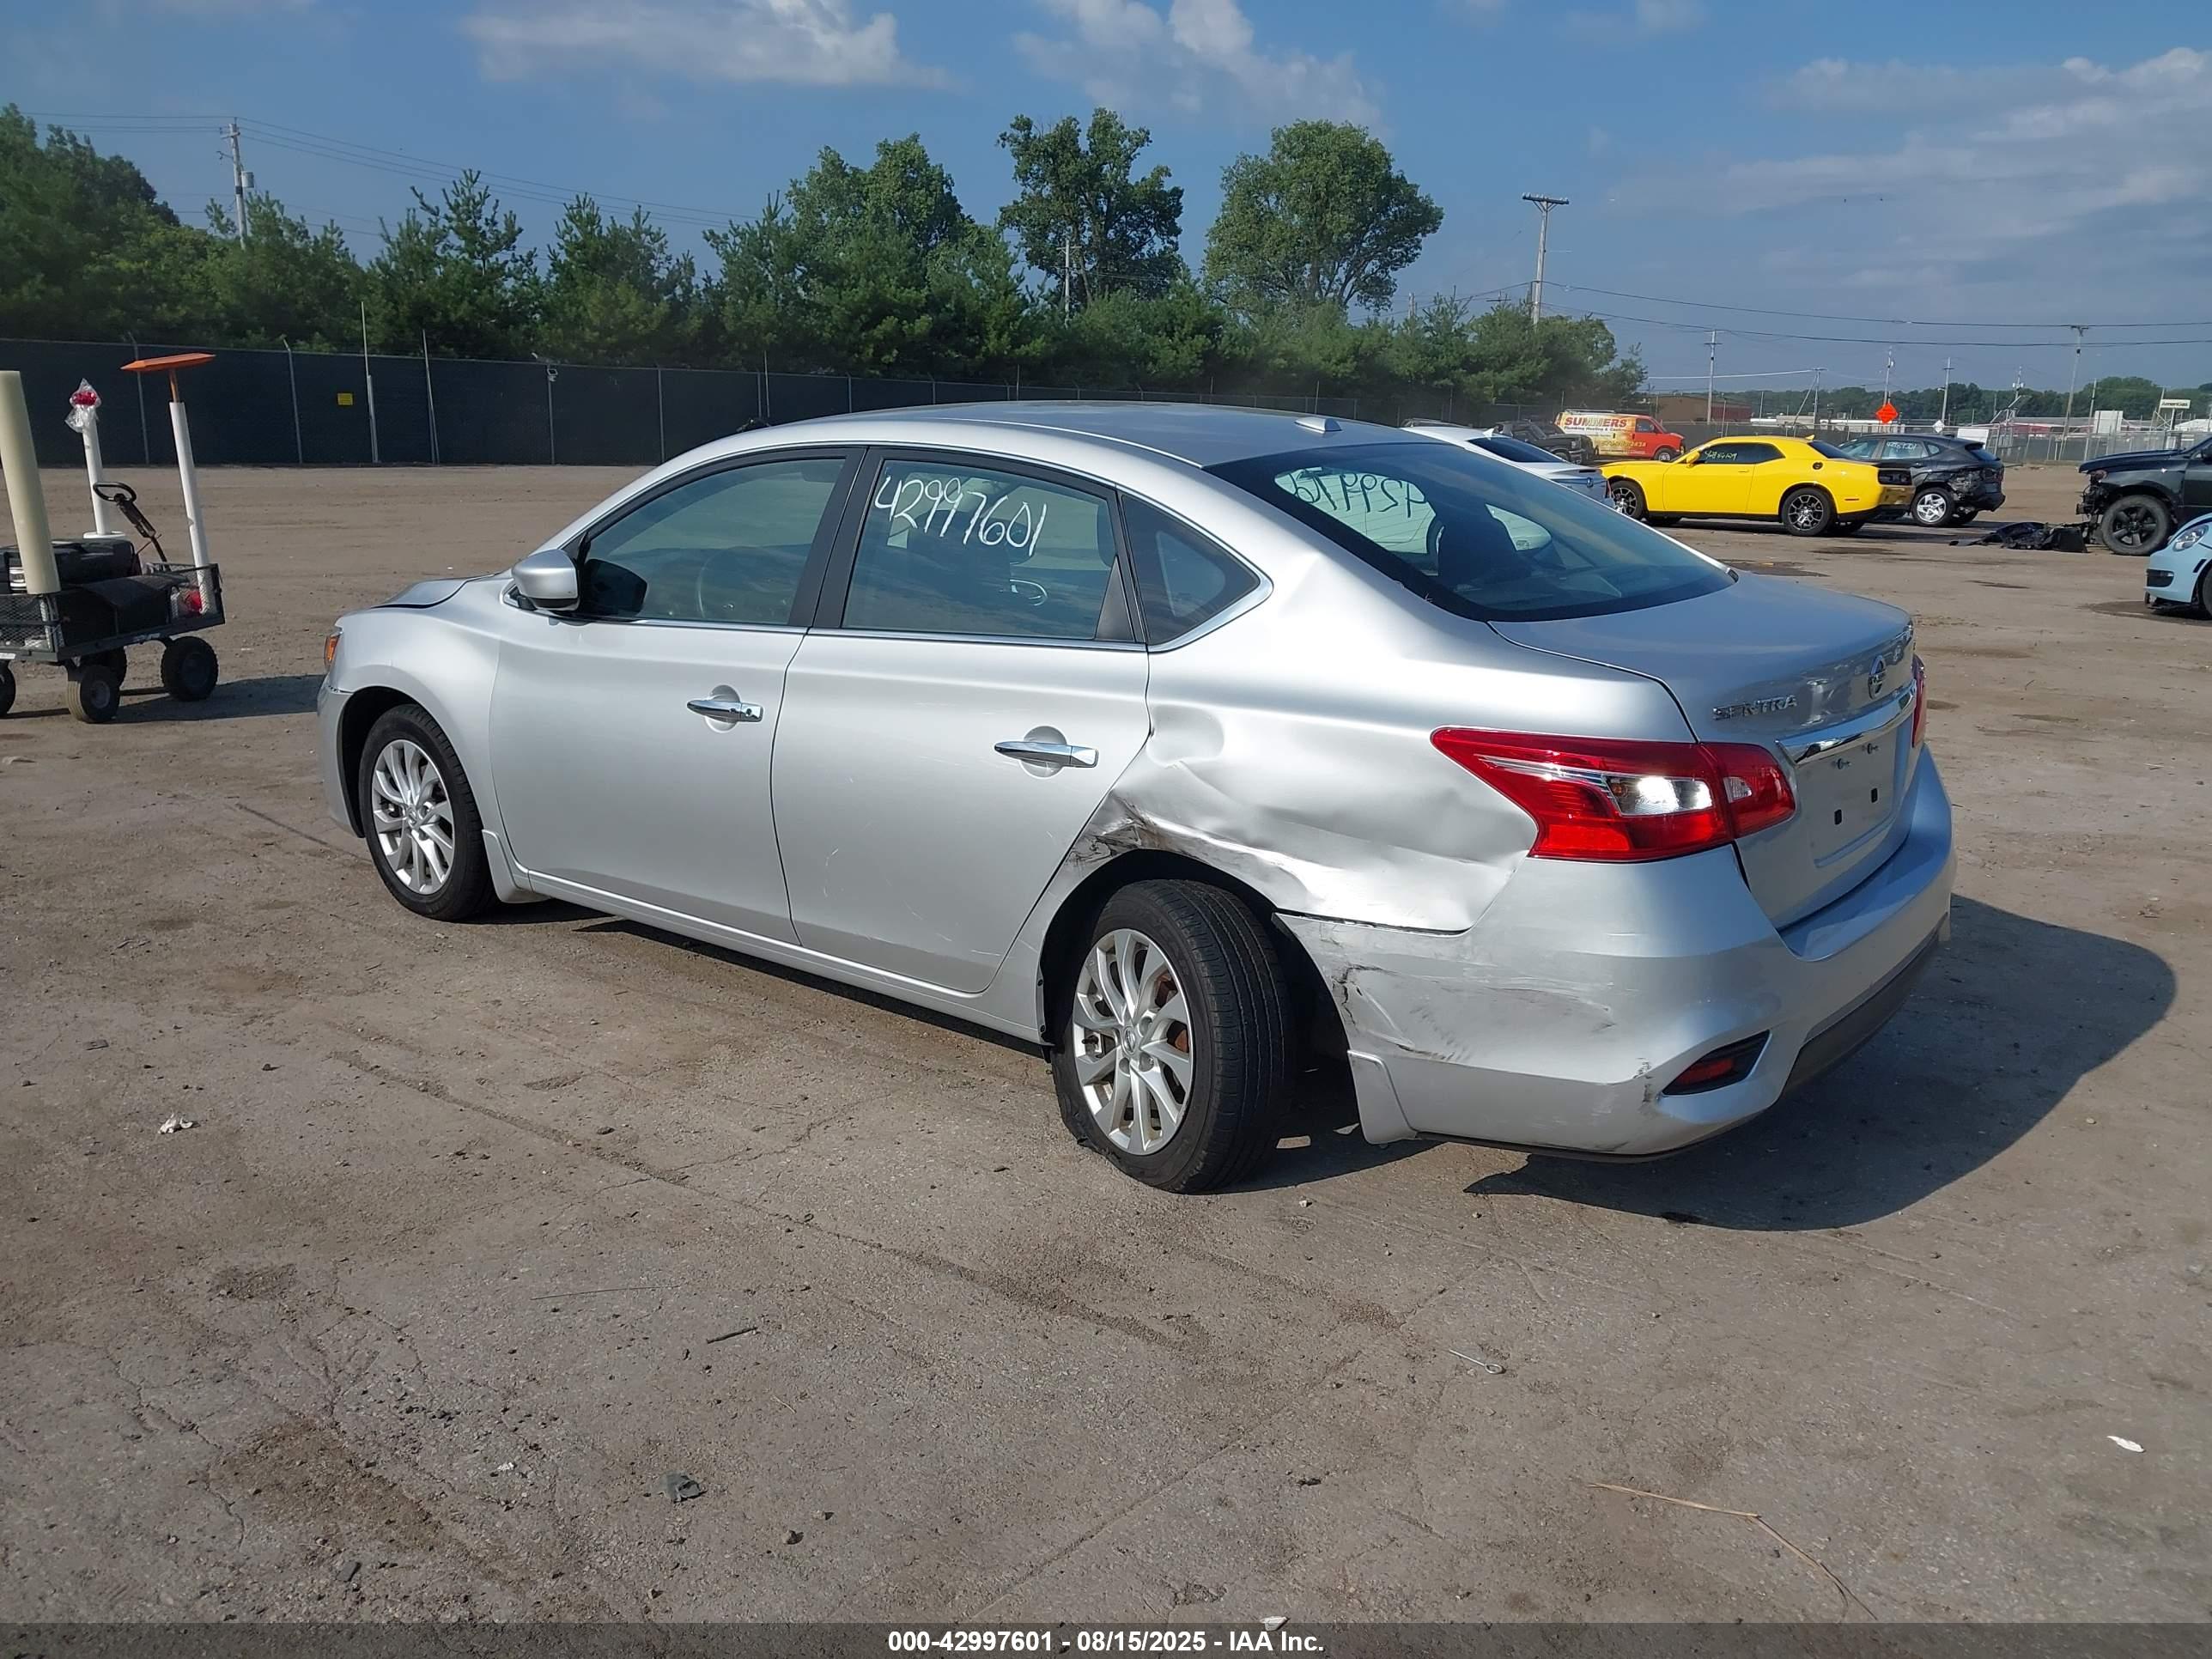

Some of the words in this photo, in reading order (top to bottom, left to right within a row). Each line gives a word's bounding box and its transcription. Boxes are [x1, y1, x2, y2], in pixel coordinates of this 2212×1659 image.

[1564, 416, 1627, 428] SUMMERS
[874, 475, 1047, 556] 42997601
[1712, 694, 1797, 720] SENTRA
